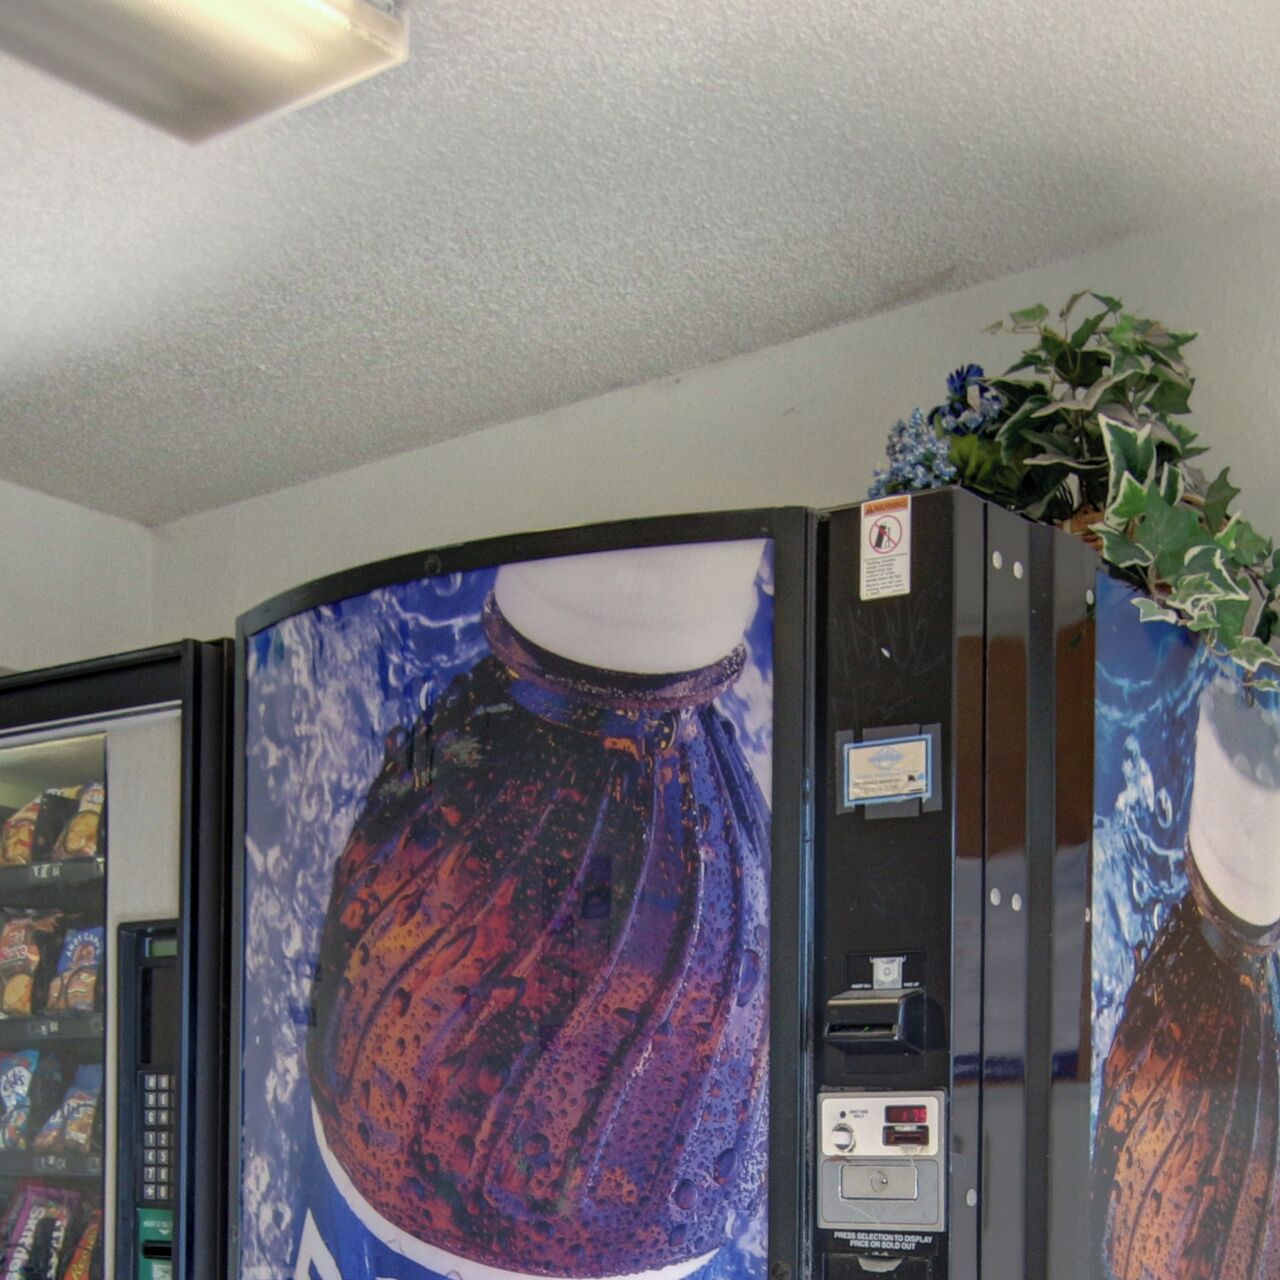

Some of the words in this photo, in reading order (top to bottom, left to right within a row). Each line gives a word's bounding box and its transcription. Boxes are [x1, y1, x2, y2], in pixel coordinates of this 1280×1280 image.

[833, 1231, 856, 1239] PRESS
[857, 1232, 893, 1241] SELECTION
[894, 1234, 903, 1242] TO
[904, 1235, 933, 1243] DISPLAY
[849, 1240, 869, 1248] PRICE
[870, 1240, 880, 1248] OR
[881, 1241, 900, 1249] SOLD
[901, 1242, 916, 1250] OUT
